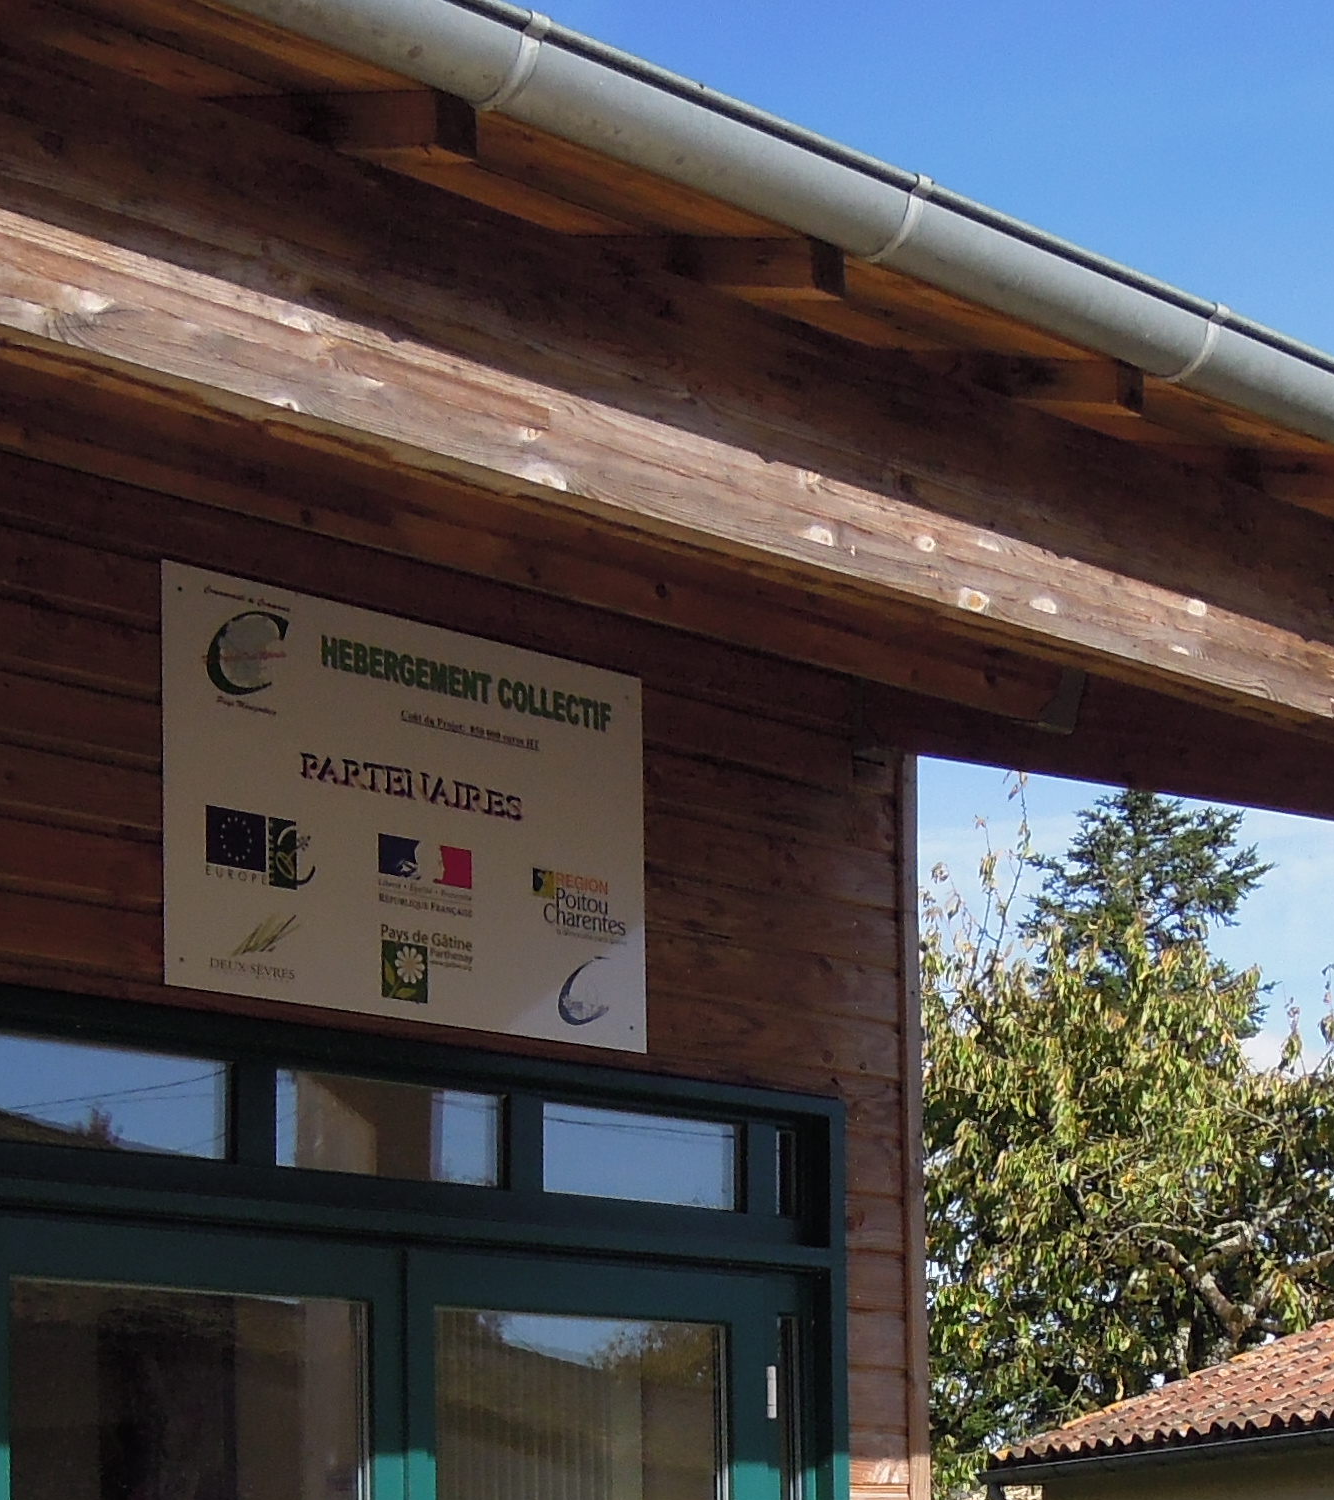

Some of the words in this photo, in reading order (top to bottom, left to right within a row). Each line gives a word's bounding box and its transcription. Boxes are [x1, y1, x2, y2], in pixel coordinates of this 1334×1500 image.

[320, 634, 492, 704] HEBERGEMENT
[498, 677, 612, 732] COLLECTIF
[299, 752, 523, 821] PARTENAIRES
[205, 866, 267, 885] EUROPE
[556, 887, 609, 915] Poitou
[543, 902, 627, 936] Charentes
[380, 924, 409, 943] Pays
[412, 929, 428, 944] de
[431, 932, 473, 952] Gâtine
